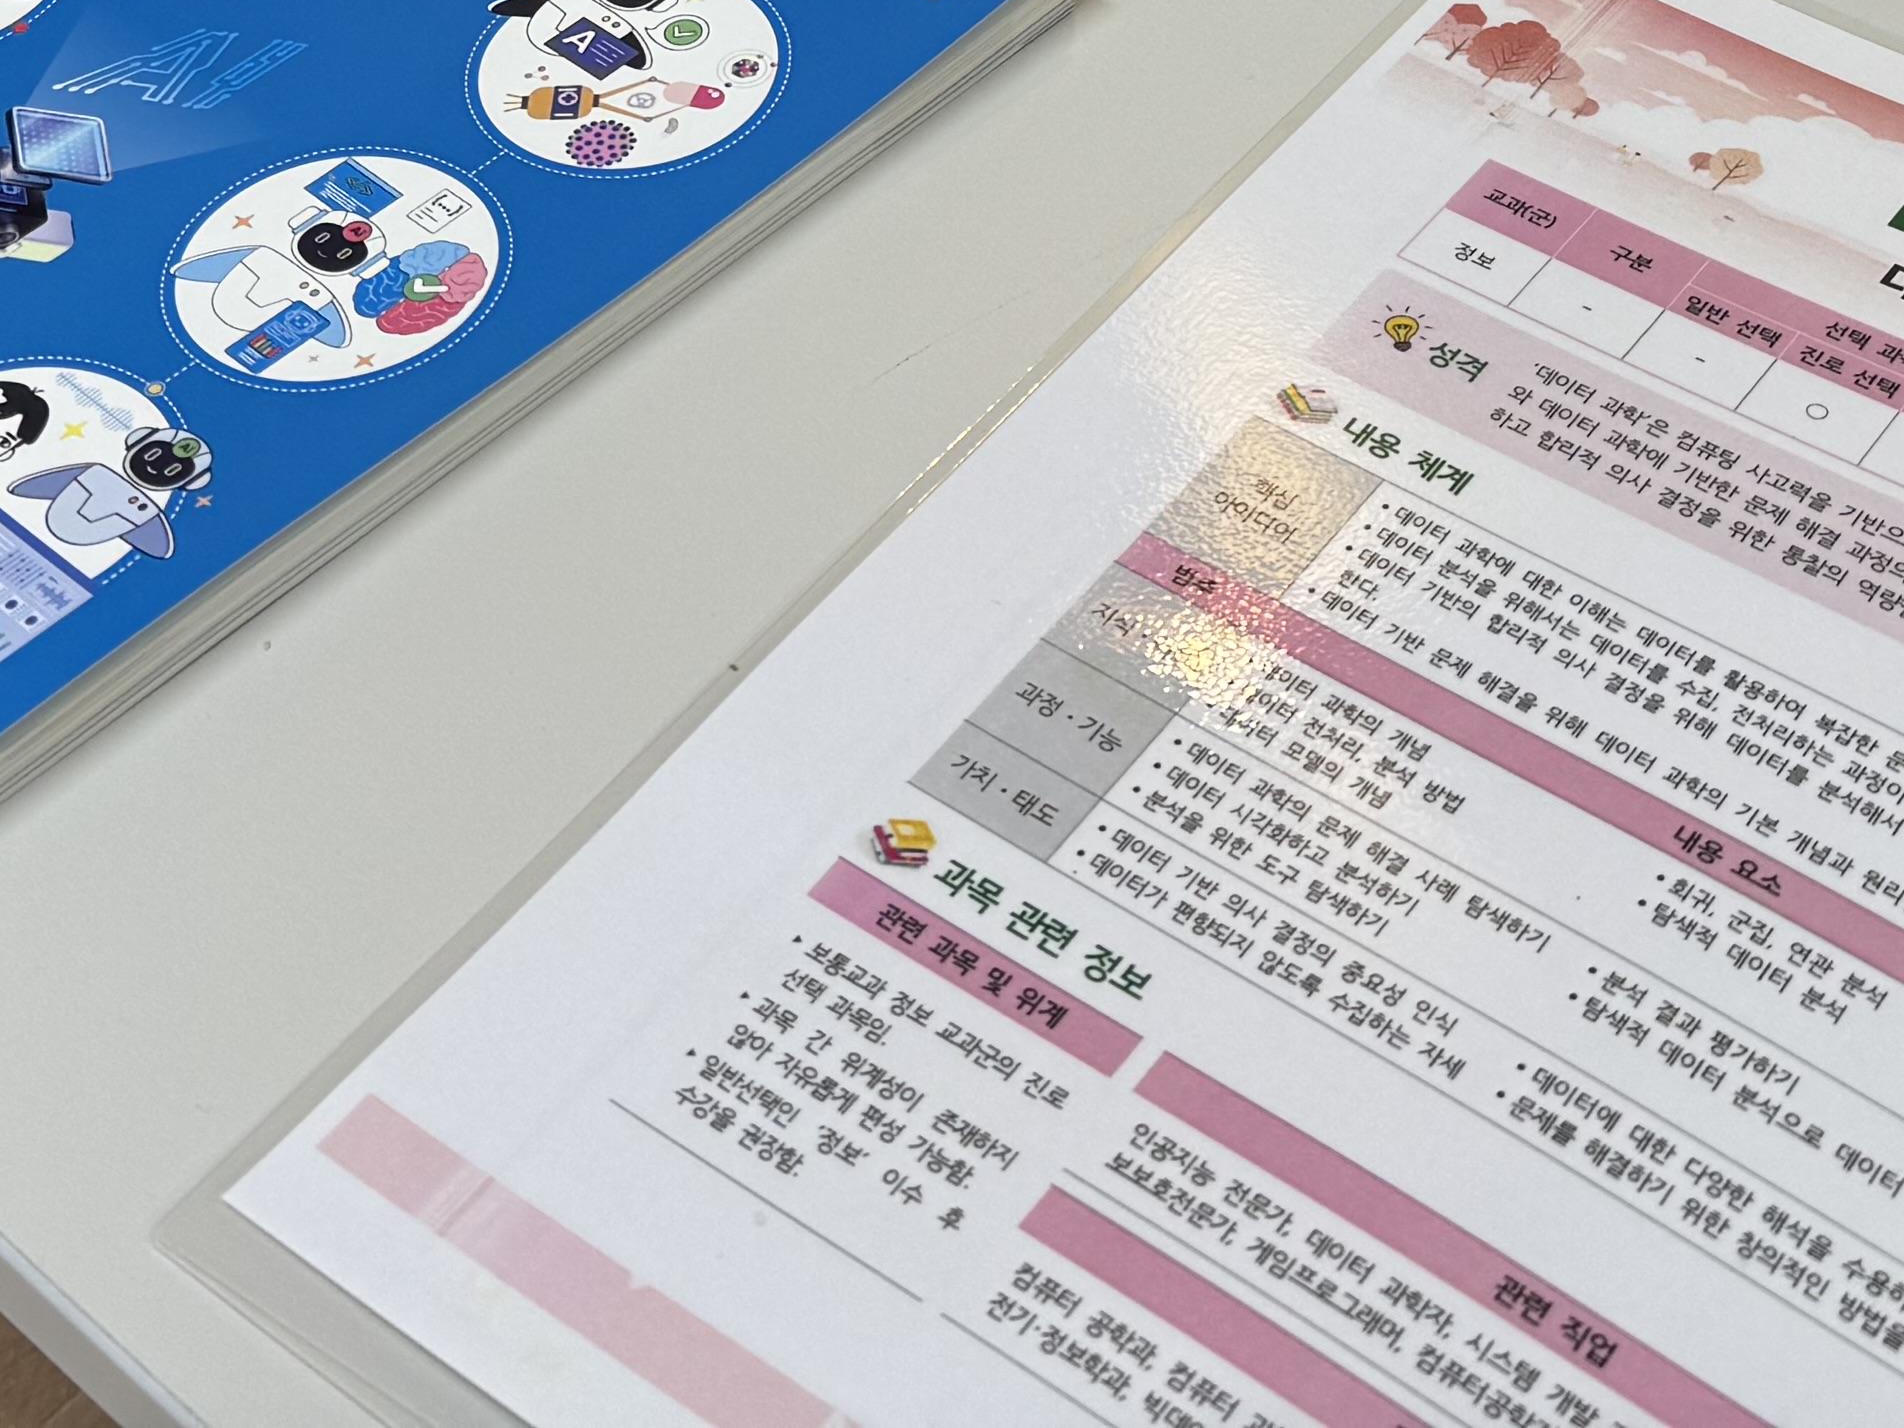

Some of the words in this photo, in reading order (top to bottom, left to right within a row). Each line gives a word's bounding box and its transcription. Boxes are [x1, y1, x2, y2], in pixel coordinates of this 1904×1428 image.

[1482, 187, 1558, 230] 교과(군)
[1454, 241, 1496, 271] 정보
[1609, 244, 1654, 274] 구분
[1684, 295, 1731, 326] 일반
[1735, 319, 1783, 349] 선택
[1824, 320, 1873, 352] 선택
[1428, 341, 1489, 384] 성격
[1799, 344, 1846, 376] 진로
[1852, 368, 1902, 400] 선택
[1342, 416, 1402, 460] 내용
[1407, 449, 1475, 497] 체계
[1672, 824, 1724, 865] 내용
[1729, 858, 1782, 898] 요소
[932, 858, 1005, 915] 과목
[1004, 900, 1079, 960] 관련
[1083, 943, 1153, 1001] 정보
[874, 902, 929, 946] 관련
[926, 934, 980, 977] 과목
[980, 966, 1014, 998] 및
[1015, 986, 1070, 1030] 위계
[1492, 1273, 1554, 1328] 관련
[1559, 1315, 1619, 1369] 직업
